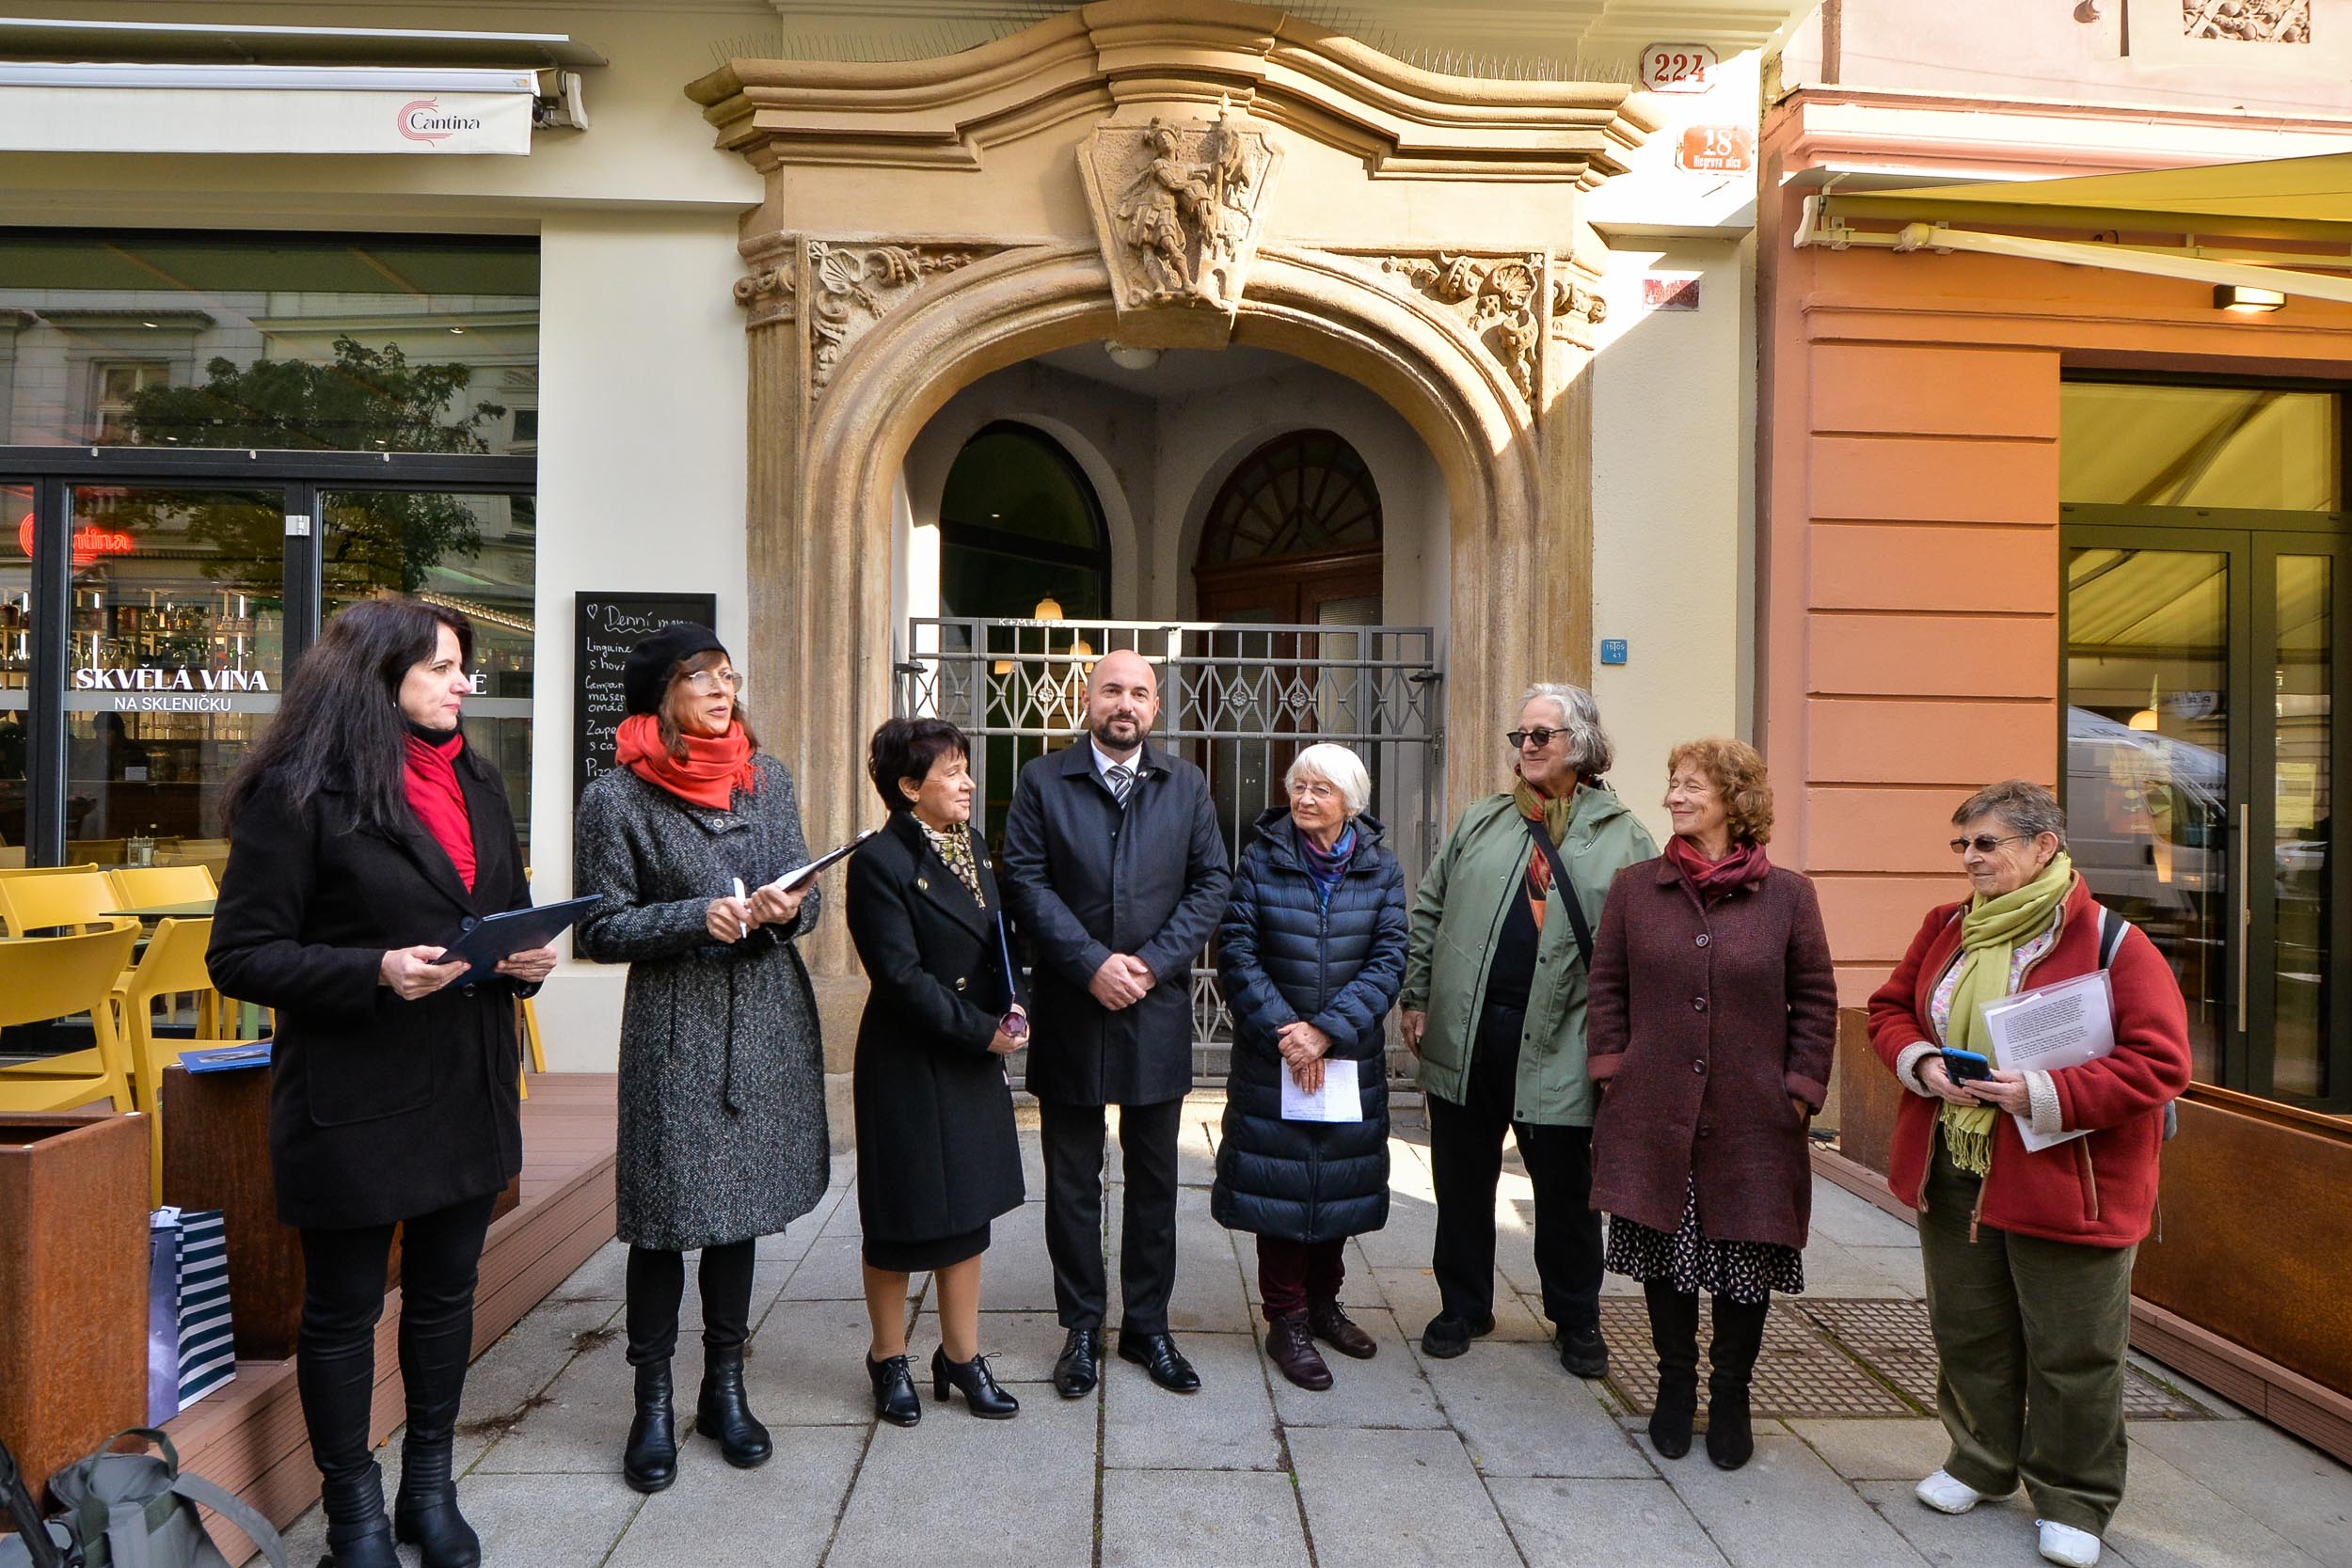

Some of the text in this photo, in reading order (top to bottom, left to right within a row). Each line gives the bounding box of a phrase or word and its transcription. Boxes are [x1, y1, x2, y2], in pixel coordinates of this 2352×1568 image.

[1654, 53, 1706, 83] 224
[410, 111, 481, 130] Cantina
[1703, 128, 1732, 156] 18
[72, 527, 128, 550] ntina
[604, 605, 653, 626] Denní
[587, 636, 633, 658] Linguine
[75, 664, 269, 691] SKVĚLÁ VÍNA
[114, 694, 231, 712] NA SKLENIČKU
